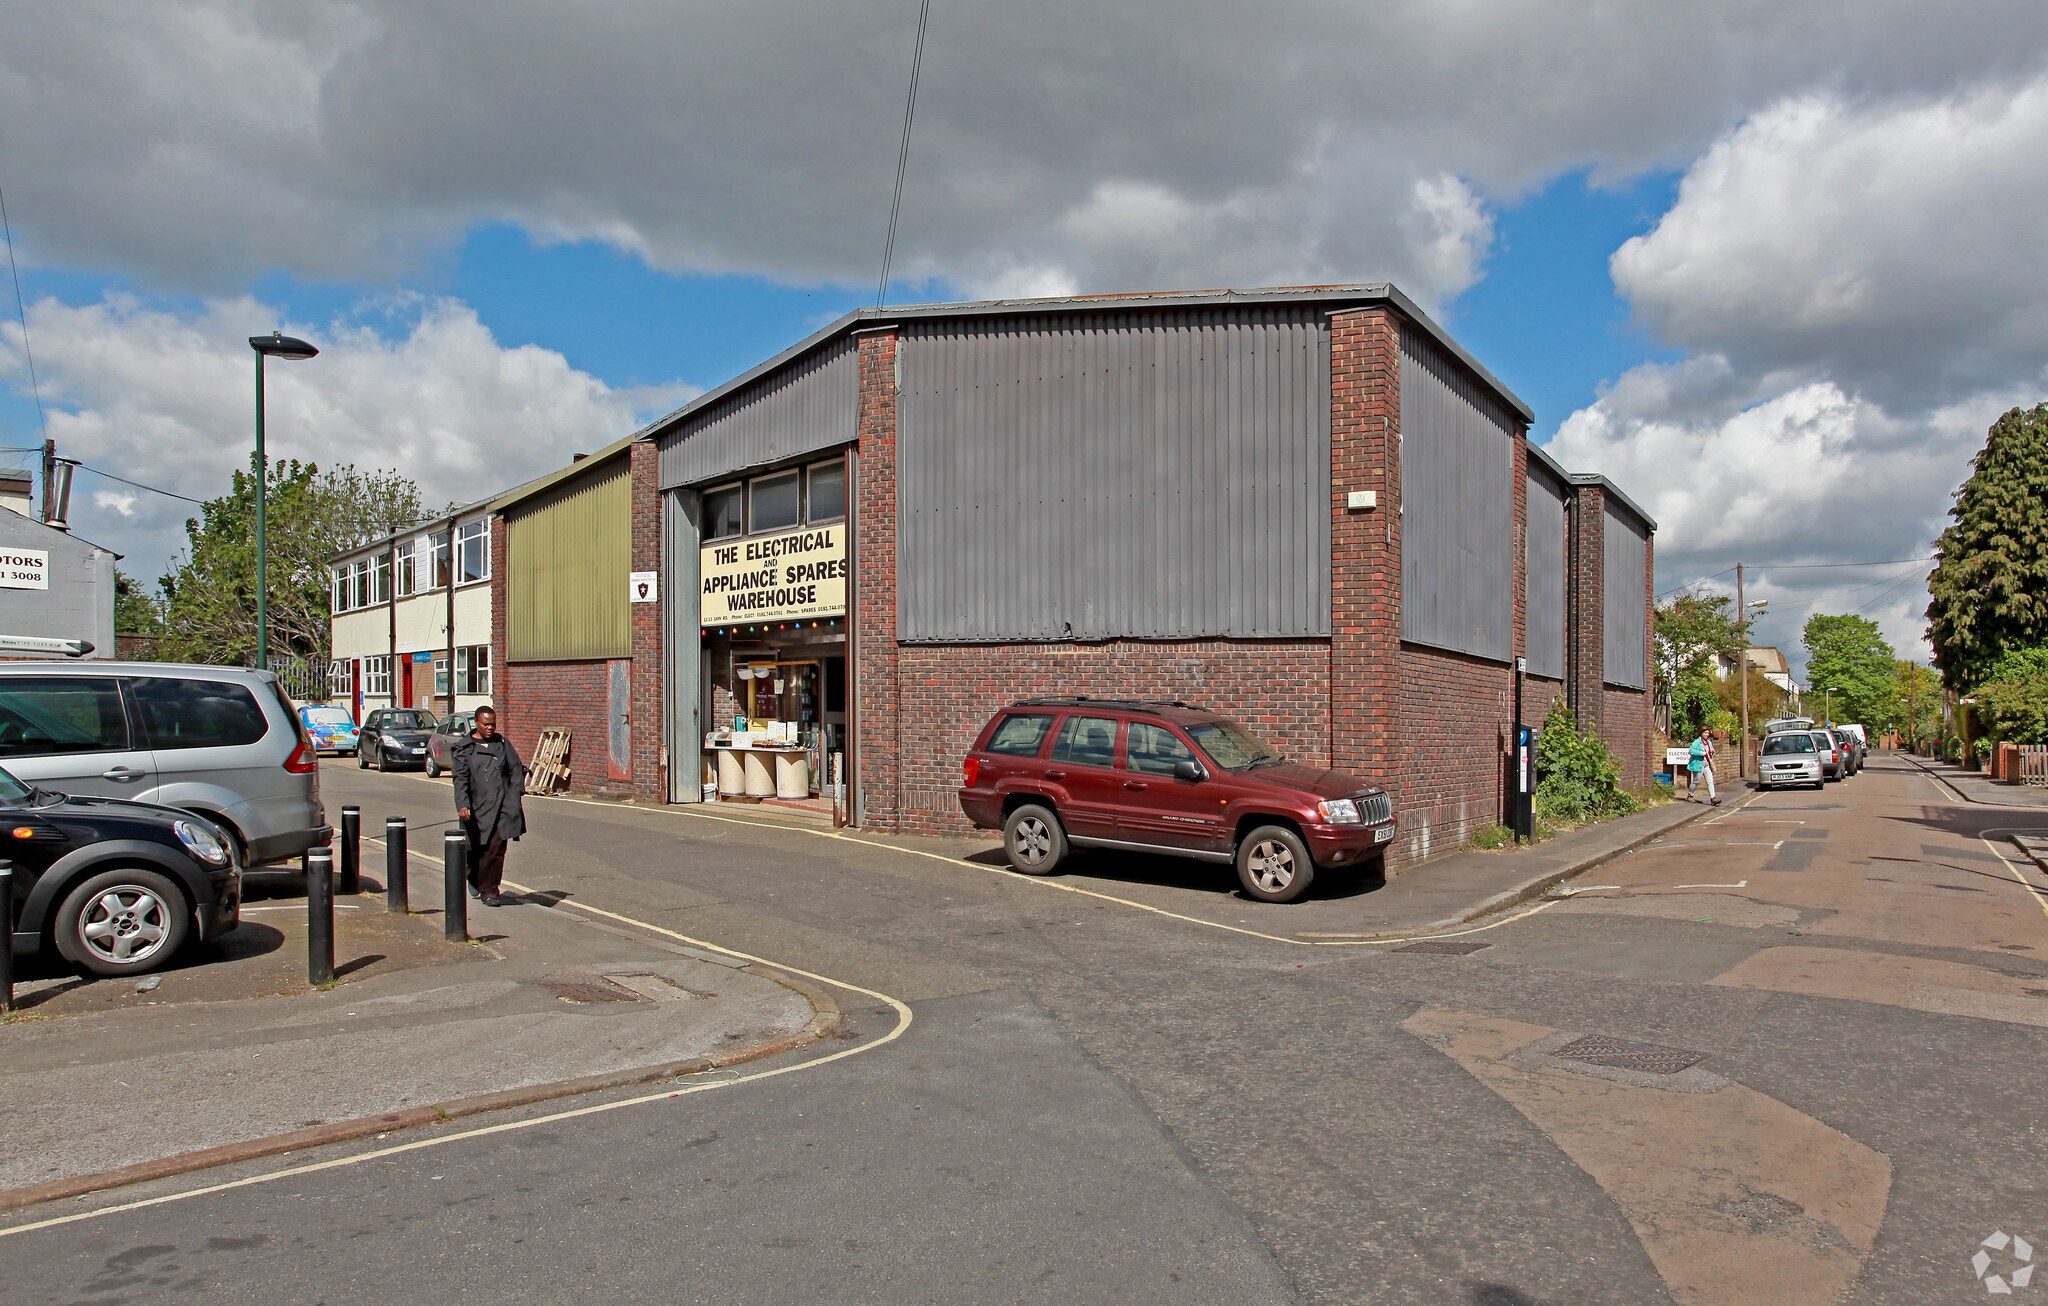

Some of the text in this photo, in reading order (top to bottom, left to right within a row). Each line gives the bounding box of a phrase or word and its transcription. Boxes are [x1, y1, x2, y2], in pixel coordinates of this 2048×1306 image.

[715, 530, 834, 565] THE ELECTRICAL
[0, 555, 44, 568] TORS
[763, 559, 778, 568] AND
[11, 571, 41, 581] 3008
[703, 559, 846, 594] APPLIANCE SPARES
[727, 585, 816, 611] WAREHOUSE
